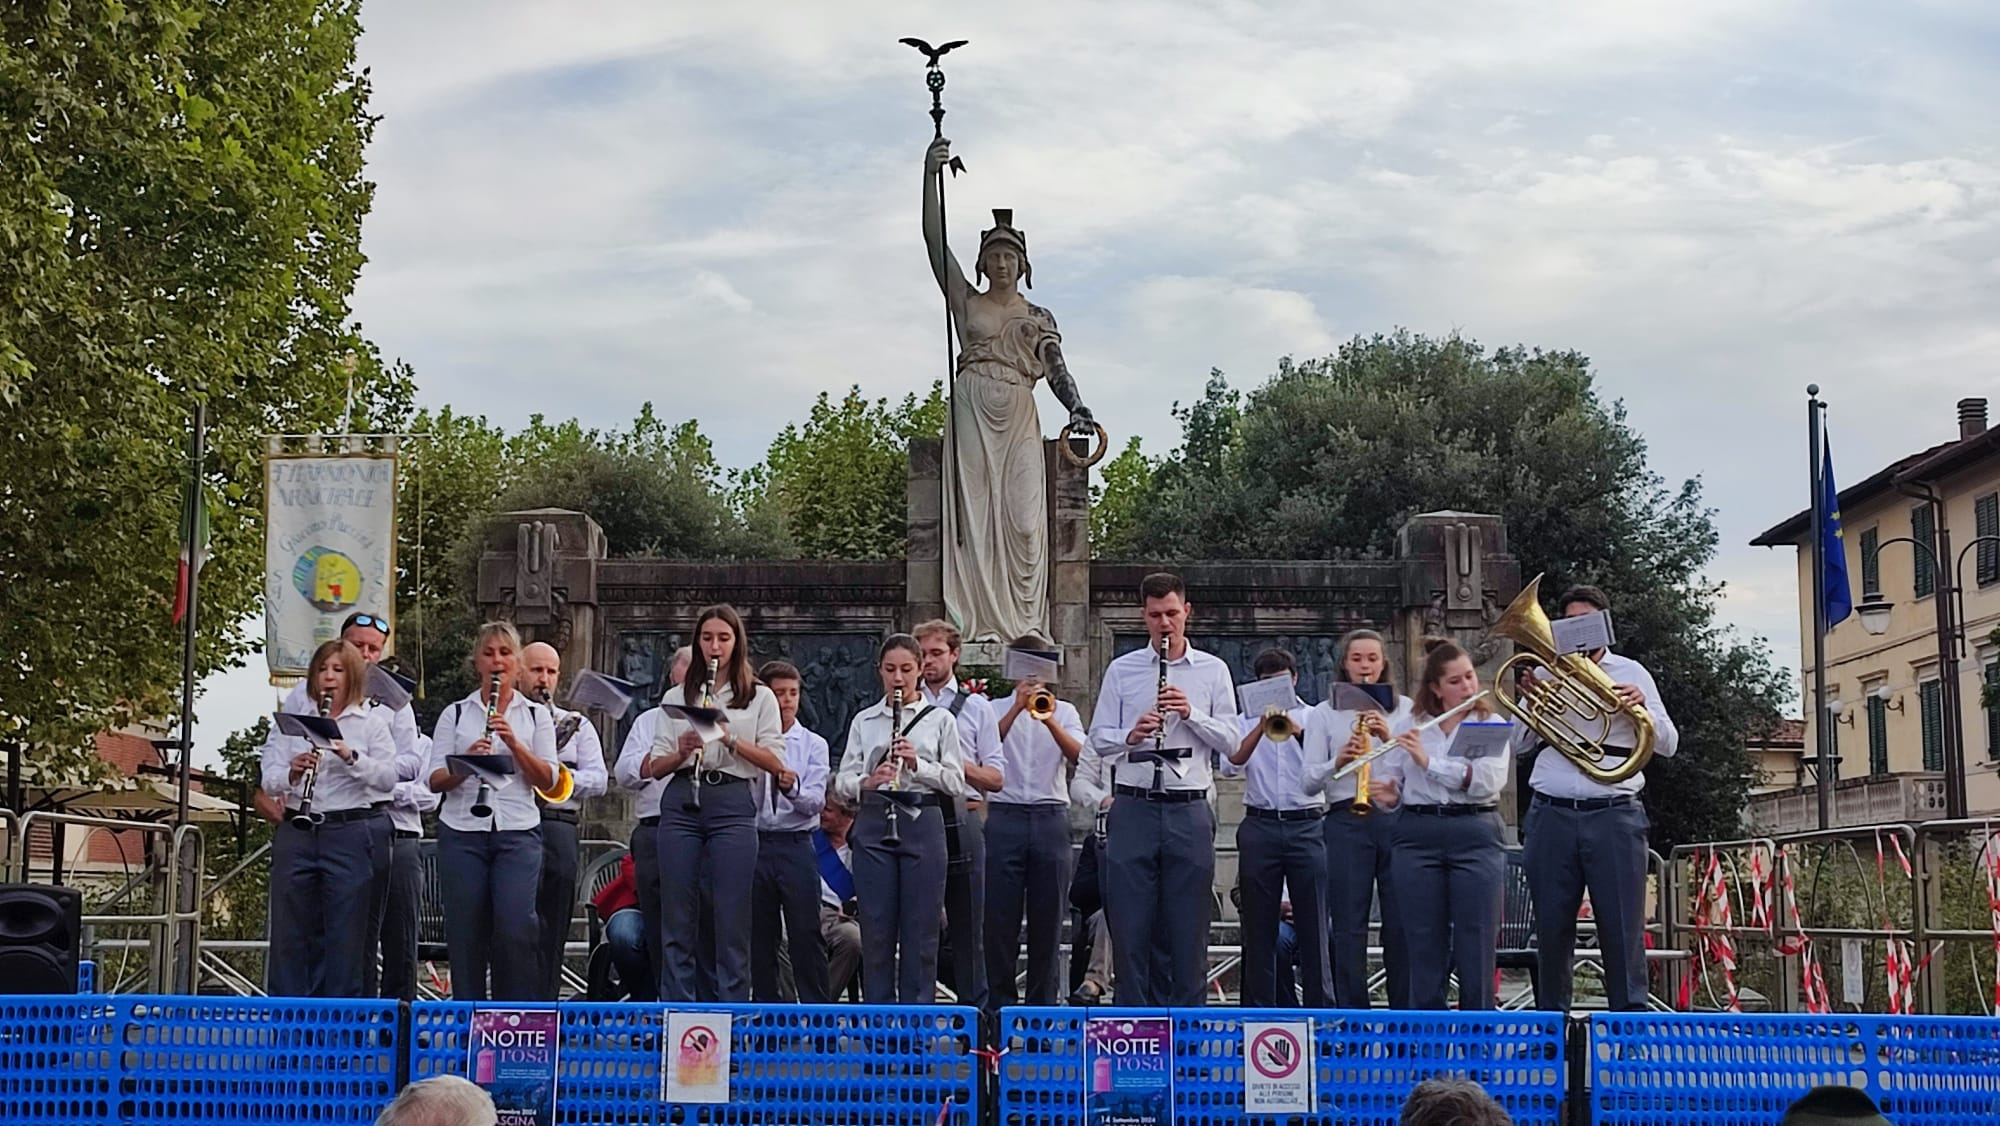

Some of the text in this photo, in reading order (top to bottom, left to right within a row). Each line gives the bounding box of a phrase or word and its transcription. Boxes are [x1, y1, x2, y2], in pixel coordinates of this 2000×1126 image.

[481, 1030, 546, 1047] NOTTE
[1096, 1038, 1160, 1056] NOTTE
[501, 1048, 550, 1064] rosa
[1117, 1056, 1165, 1072] rosa
